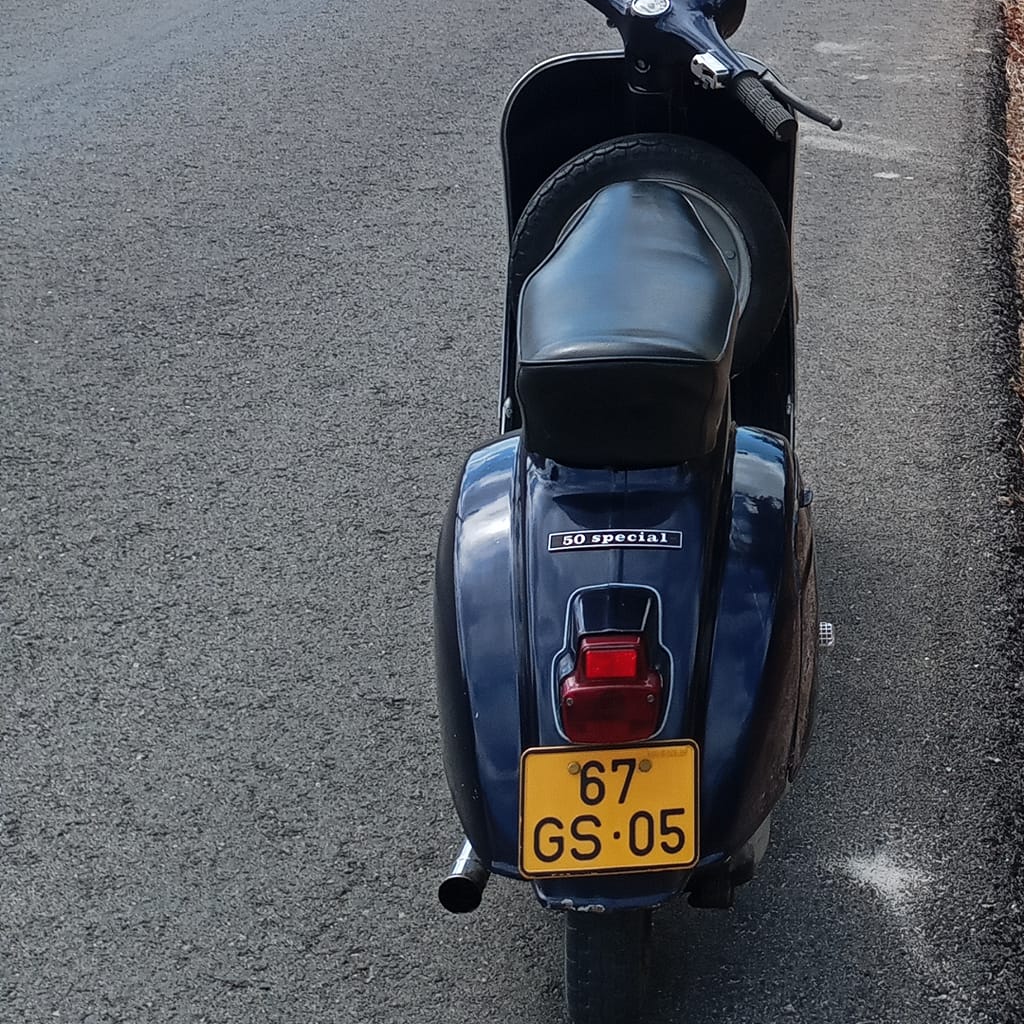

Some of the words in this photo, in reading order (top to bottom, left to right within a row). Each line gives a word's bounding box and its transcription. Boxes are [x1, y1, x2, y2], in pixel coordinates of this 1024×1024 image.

[562, 534, 586, 545] 50
[591, 531, 668, 544] special
[580, 757, 636, 806] 67
